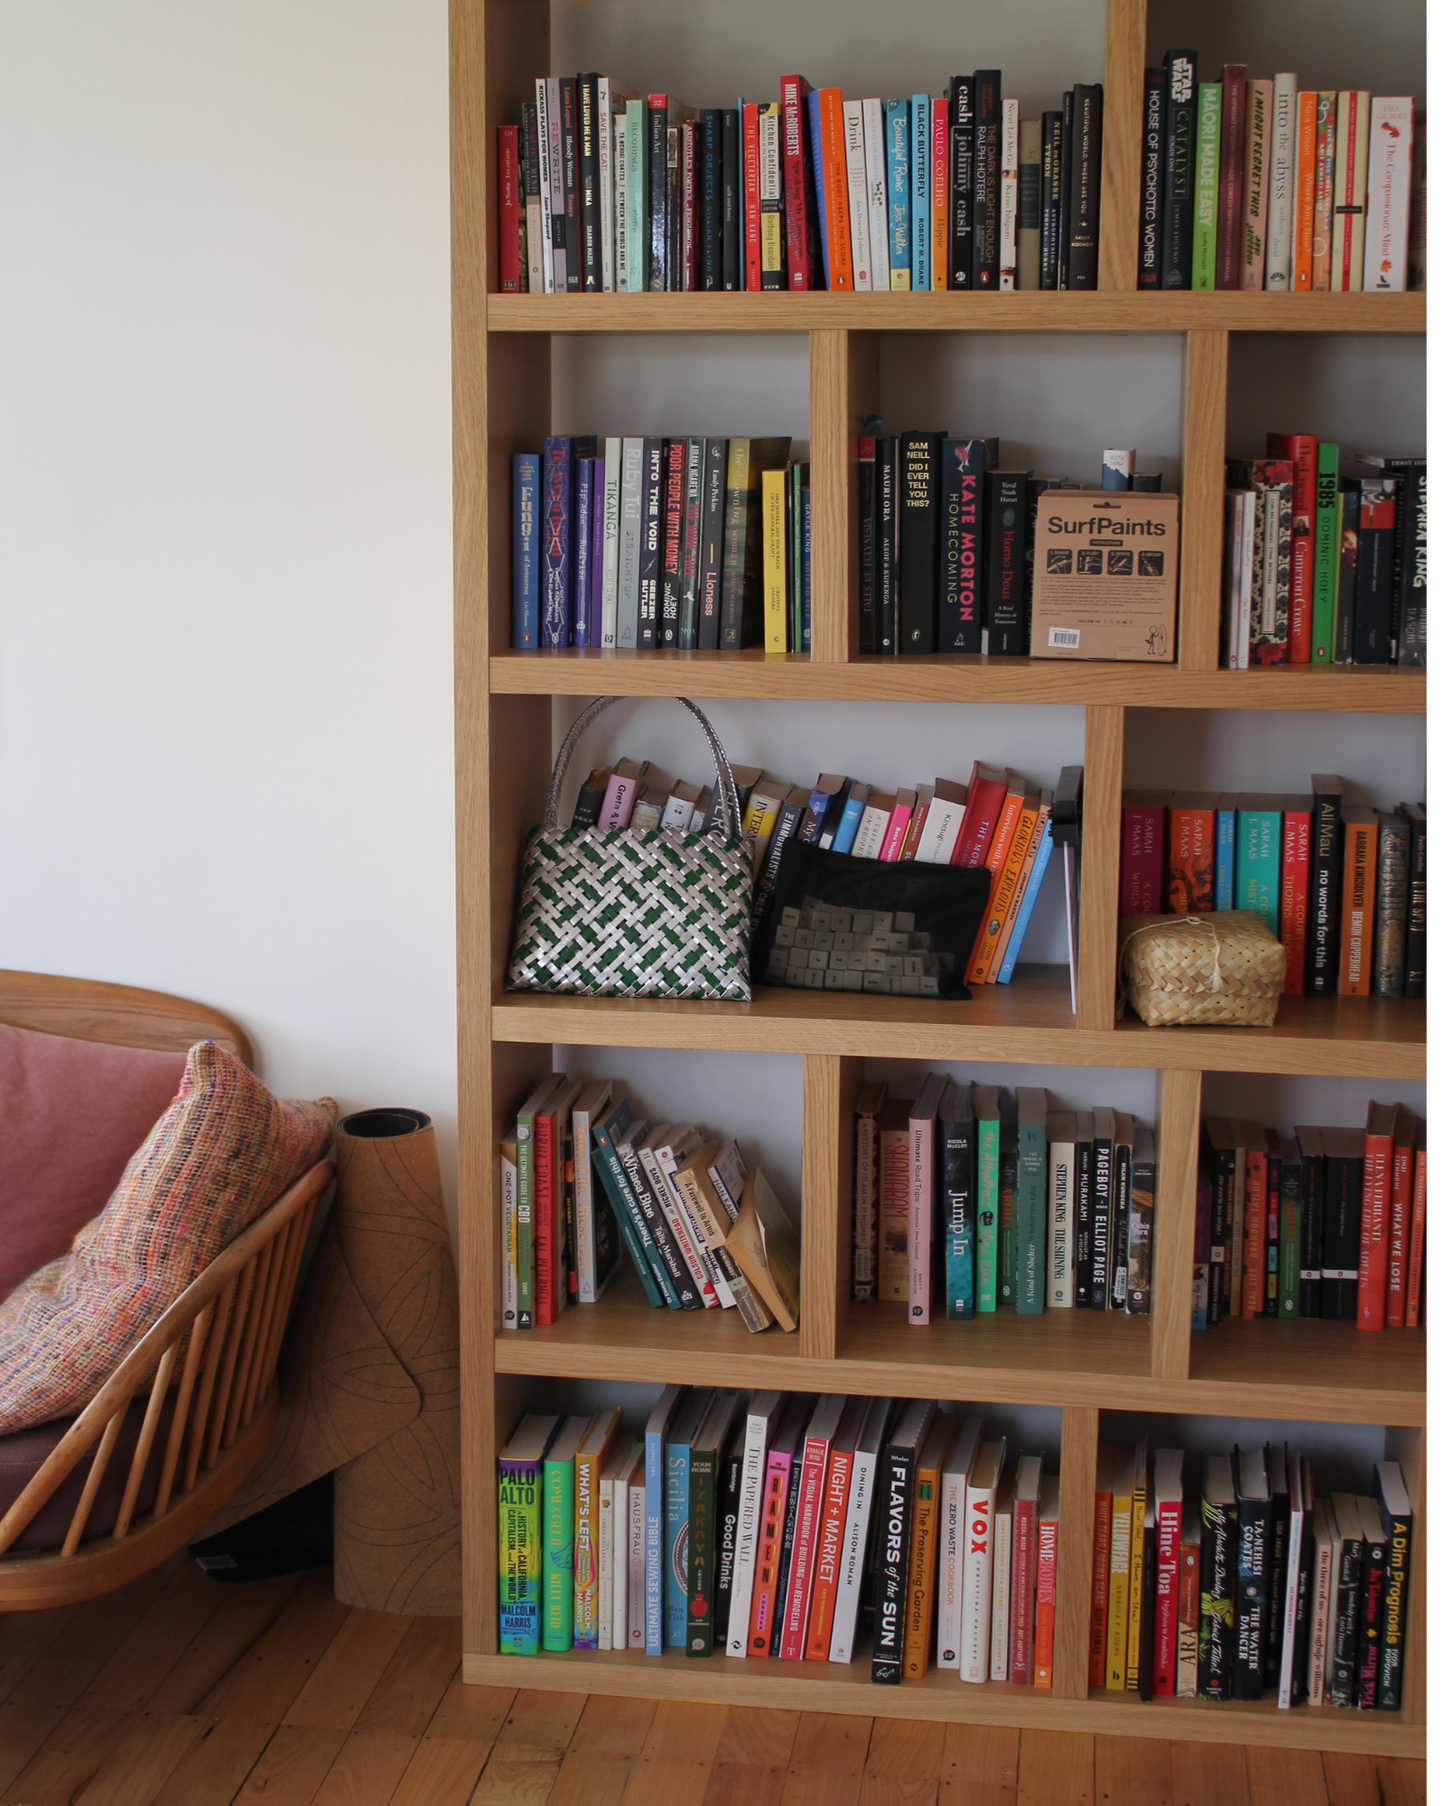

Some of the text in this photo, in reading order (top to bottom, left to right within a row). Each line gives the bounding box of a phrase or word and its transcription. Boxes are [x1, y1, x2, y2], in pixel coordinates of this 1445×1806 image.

[958, 86, 972, 123] cash
[1171, 58, 1184, 103] WARS
[1179, 57, 1192, 103] STAR
[785, 84, 799, 156] MIKE McROBERTS
[848, 117, 862, 152] Drink
[552, 121, 561, 195] REWRITE
[564, 135, 572, 160] Bloody
[767, 116, 776, 199] Kitchen Confidential
[976, 126, 987, 203] RALPH HOTERE
[1200, 144, 1214, 185] MADE
[1273, 93, 1292, 199] into the abyss
[935, 160, 943, 206] COELHO
[954, 134, 972, 237] johnny cash
[1144, 90, 1160, 267] HOUSE OF PSYCHOTIC WOMEN
[1381, 142, 1396, 256] The Compassionate Mind
[1198, 190, 1213, 227] EASY
[907, 451, 930, 459] NEILL
[909, 442, 928, 450] SAM
[909, 463, 922, 471] DID
[622, 449, 641, 519] Ruby Tui
[648, 450, 659, 551] INTO THE VOID
[907, 472, 929, 480] EVER
[908, 481, 928, 489] TELL
[909, 490, 927, 498] YOU
[1318, 471, 1336, 509] 1985
[606, 480, 617, 540] TIKANGA
[665, 444, 682, 575] POOR PEOPLE WITH MONEY
[906, 499, 929, 507] THIS?
[1047, 516, 1166, 536] SurfPaints
[947, 493, 958, 603] HOMECOMING
[960, 475, 976, 621] KATE MORTON
[1002, 531, 1014, 600] Homo Deus
[1318, 516, 1330, 603] DOMINIC HOEY
[641, 579, 649, 619] BUTLER
[648, 579, 656, 619] GEEZER
[705, 572, 717, 616] Lioness
[1292, 541, 1307, 636] Cameron Crowe
[613, 784, 626, 809] Greta
[785, 812, 795, 820] THE
[936, 814, 952, 842] Kintsugi
[1180, 826, 1189, 858] MAAS
[1194, 819, 1202, 856] SARAH
[1319, 803, 1334, 857] Ali Mau
[994, 816, 1033, 913] GLORIOUS EXPLOITS
[1353, 831, 1367, 908] BARBARA KINGSOLVER
[1315, 870, 1329, 968] no words for this
[1348, 911, 1363, 982] DEMON COPPERHEAD
[536, 1122, 549, 1200] BURNT TOAST
[576, 1125, 591, 1240] Times Like These
[623, 1153, 654, 1219] Whaea Blue
[1096, 1148, 1109, 1197] PAGEBOY
[518, 1204, 530, 1224] CBD
[688, 1188, 704, 1212] Farewell
[699, 1213, 708, 1221] to
[1001, 1186, 1012, 1229] AROHA
[1055, 1164, 1067, 1223] STEPHEN KING
[1080, 1173, 1088, 1221] MURAKAMI
[703, 1221, 714, 1236] Arms
[948, 1190, 968, 1256] Jump In
[1390, 1203, 1403, 1291] WHAT WE LOSE
[672, 1218, 703, 1280] COLSON WHITEHEAD
[1054, 1228, 1065, 1279] THE SHINING
[1093, 1215, 1107, 1284] ELLIOT PAGE
[500, 1467, 535, 1486] PALO
[500, 1486, 534, 1505] ALTO
[668, 1456, 686, 1522] Sicilia
[831, 1456, 848, 1505] NIGHT
[857, 1467, 867, 1498] DINING
[632, 1493, 641, 1555] HAUSFRAU
[740, 1447, 761, 1565] THE PAPERED WALL
[762, 1477, 779, 1584] RAMEN
[784, 1490, 797, 1548] 世界で人気の和食
[949, 1503, 957, 1526] ZERO
[971, 1500, 988, 1555] VOX
[579, 1519, 590, 1551] LEFT
[719, 1514, 736, 1590] Good Drinks
[820, 1518, 839, 1584] MARKET
[847, 1522, 859, 1585] ALISON ROMAN
[880, 1466, 906, 1647] FLAVORS of the SUN
[948, 1527, 956, 1556] WASTE
[1111, 1511, 1130, 1575] YELLOWFACE
[1158, 1511, 1178, 1596] Hine Toa
[1243, 1526, 1253, 1569] COATES
[1391, 1537, 1406, 1567] Dim
[648, 1516, 659, 1647] ULTIMATE SEWING BIBLE
[912, 1508, 930, 1631] The Preserving Garden
[946, 1558, 956, 1606] COOKBOOK
[1037, 1525, 1055, 1603] HOMEBODIES
[500, 1603, 536, 1617] MALCOLM
[505, 1616, 532, 1629] HARRIS
[1385, 1571, 1405, 1645] Prognosis
[1179, 1627, 1197, 1666] ARA
[1238, 1615, 1250, 1660] DANCER
